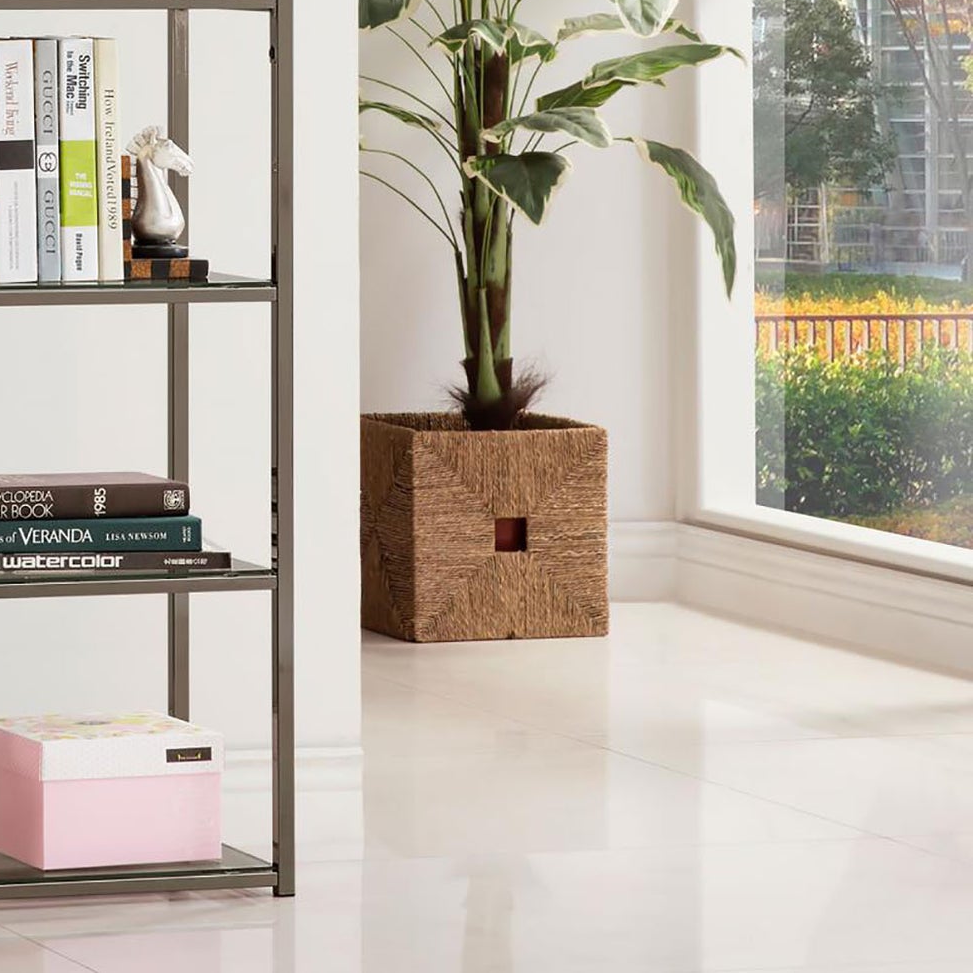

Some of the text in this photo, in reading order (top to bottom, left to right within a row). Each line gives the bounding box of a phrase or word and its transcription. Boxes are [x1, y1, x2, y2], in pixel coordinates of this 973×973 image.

[66, 60, 74, 73] the
[66, 74, 77, 99] Mac
[75, 54, 91, 110] Switching
[2, 61, 20, 135] Weekend living
[42, 69, 54, 134] GUCCI
[104, 89, 114, 116] How
[44, 190, 56, 254] GUCCI
[11, 503, 54, 518] BOOK
[94, 487, 106, 515] 1985
[5, 531, 18, 544] of
[17, 527, 93, 545] VERANDA
[105, 531, 168, 541] LISA NEWSOM
[2, 555, 124, 569] watercolor
